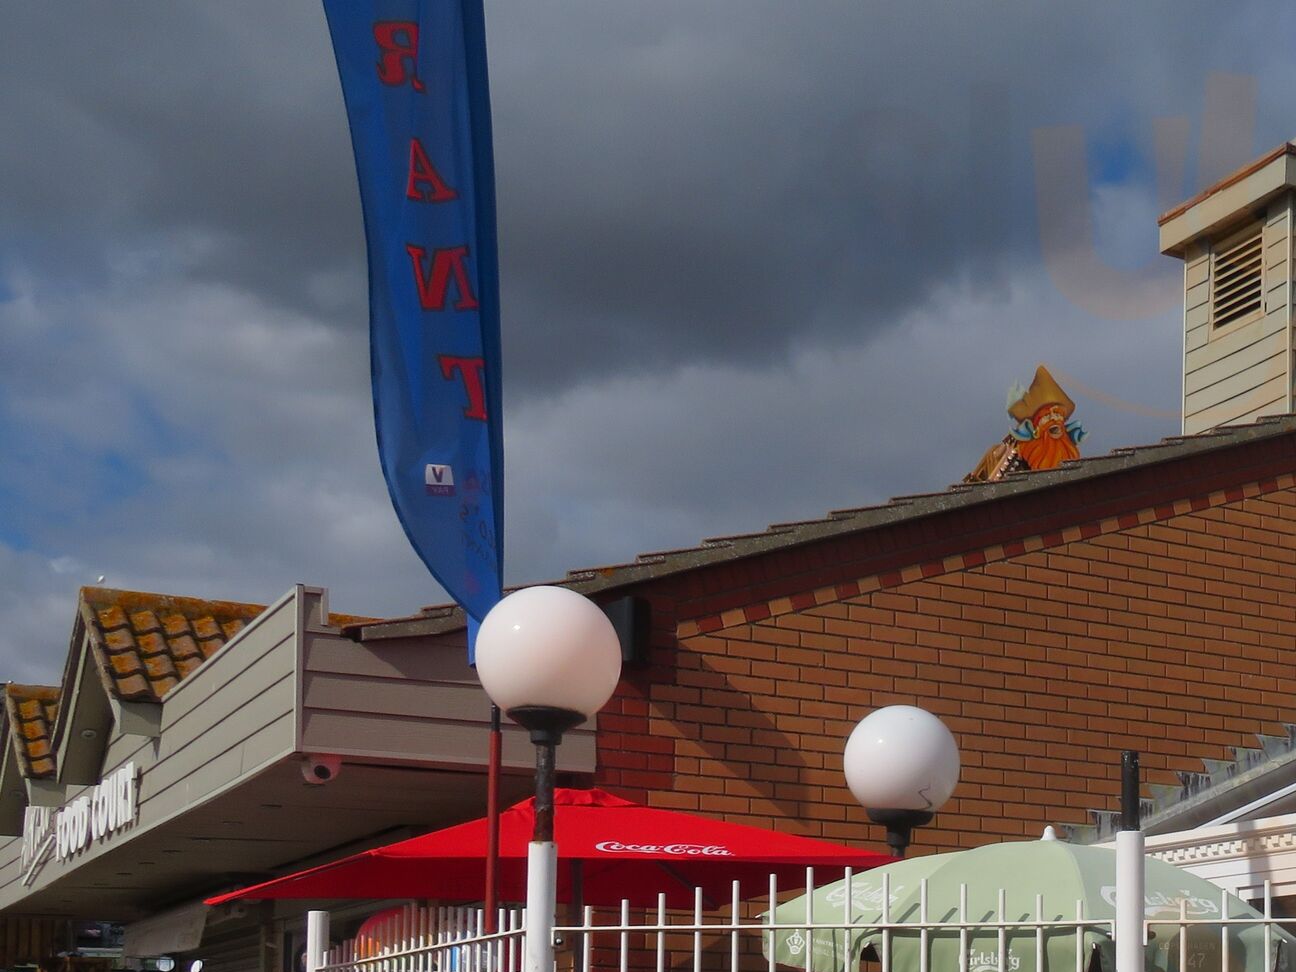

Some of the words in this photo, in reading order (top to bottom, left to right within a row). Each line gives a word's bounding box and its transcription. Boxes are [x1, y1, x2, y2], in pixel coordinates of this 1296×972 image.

[56, 796, 90, 862] FOOD
[91, 761, 134, 840] COURT
[595, 841, 732, 856] Coca-Cola
